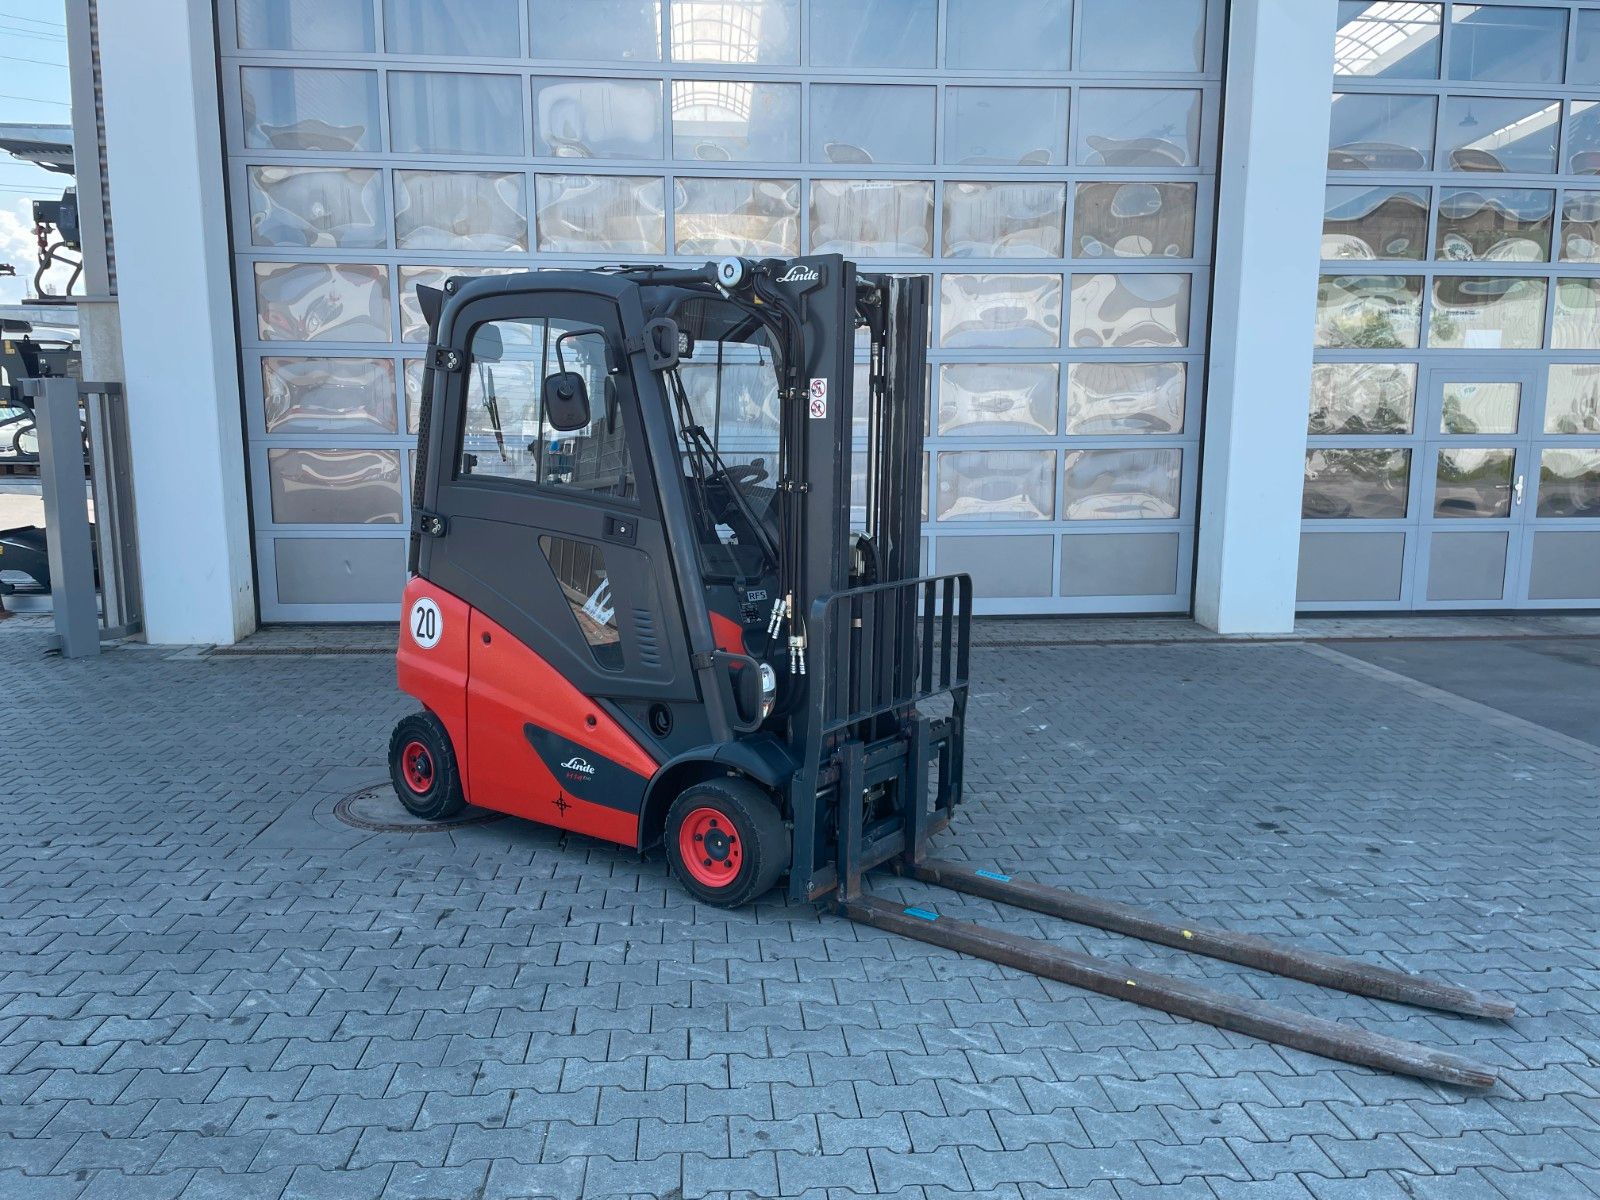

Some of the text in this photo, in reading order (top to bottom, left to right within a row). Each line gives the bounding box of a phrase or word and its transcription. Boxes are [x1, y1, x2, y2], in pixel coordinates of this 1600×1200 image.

[775, 265, 819, 282] Linde
[749, 591, 766, 600] RFS
[416, 606, 435, 640] 20
[560, 757, 595, 774] Linde
